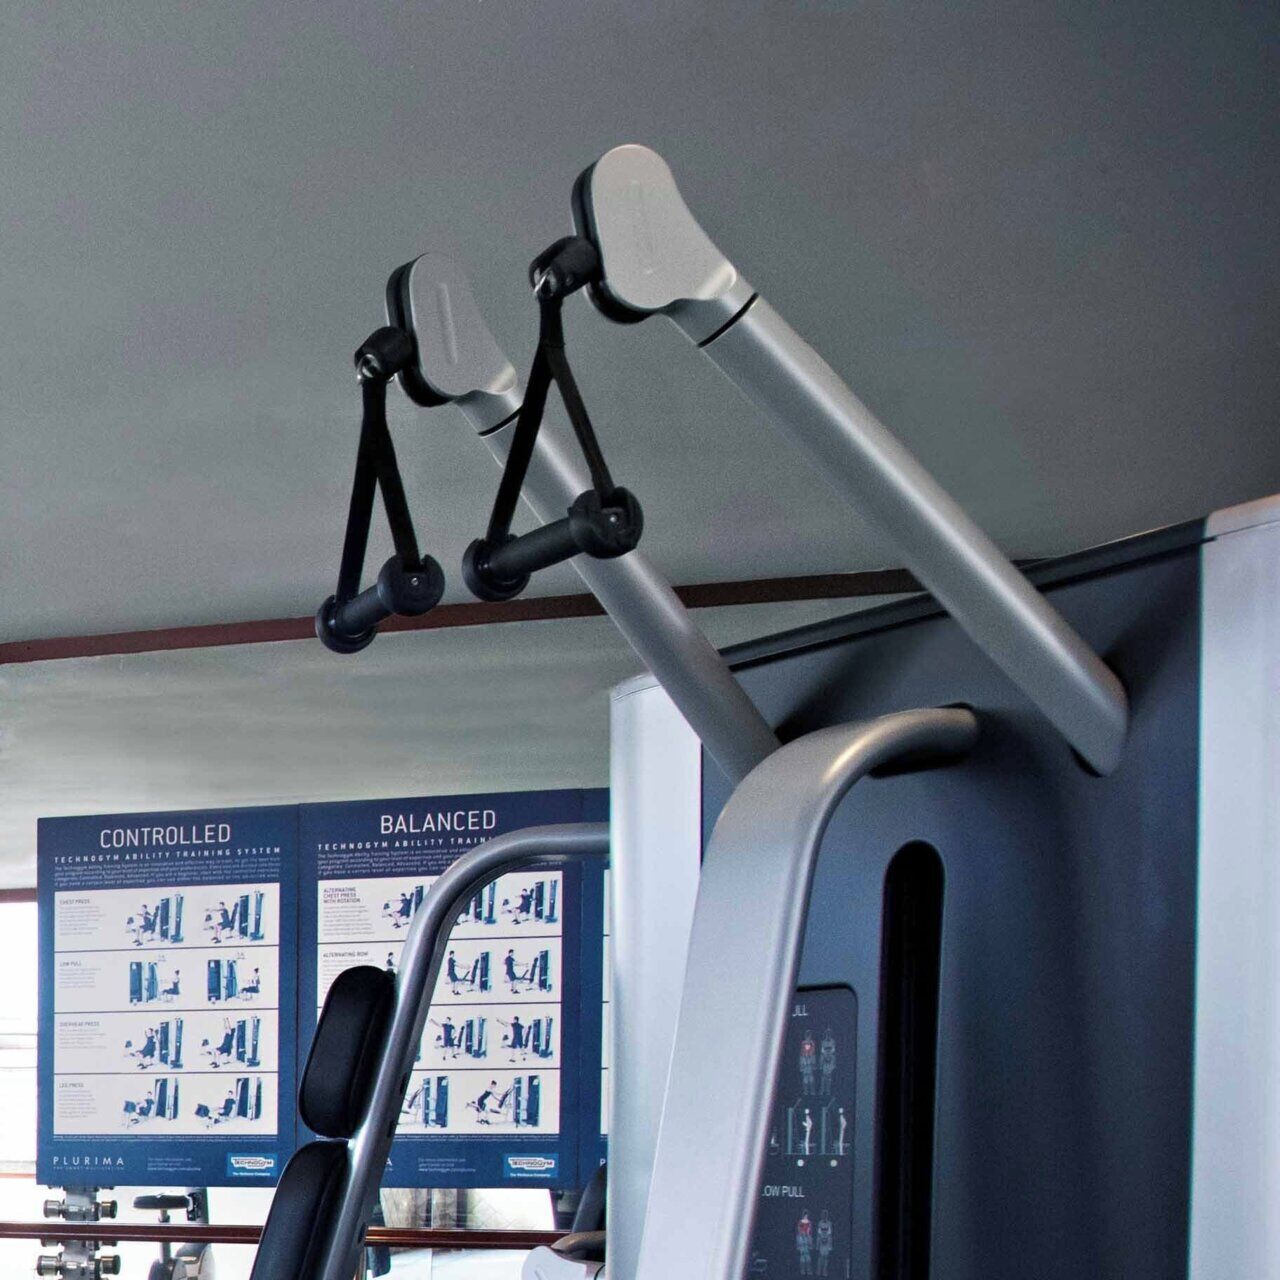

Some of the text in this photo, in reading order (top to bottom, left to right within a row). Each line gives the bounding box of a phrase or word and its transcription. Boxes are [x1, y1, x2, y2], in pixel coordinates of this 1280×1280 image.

[380, 810, 496, 835] BALANCED
[100, 823, 231, 848] CONTROLLED
[317, 837, 492, 851] TECHNOGYM ABILITY TRAIN
[54, 847, 280, 864] TECHNOGYM ABILITY TRAINING SYSTEM
[53, 1156, 124, 1166] PLURIMA
[781, 1185, 805, 1198] PULL
